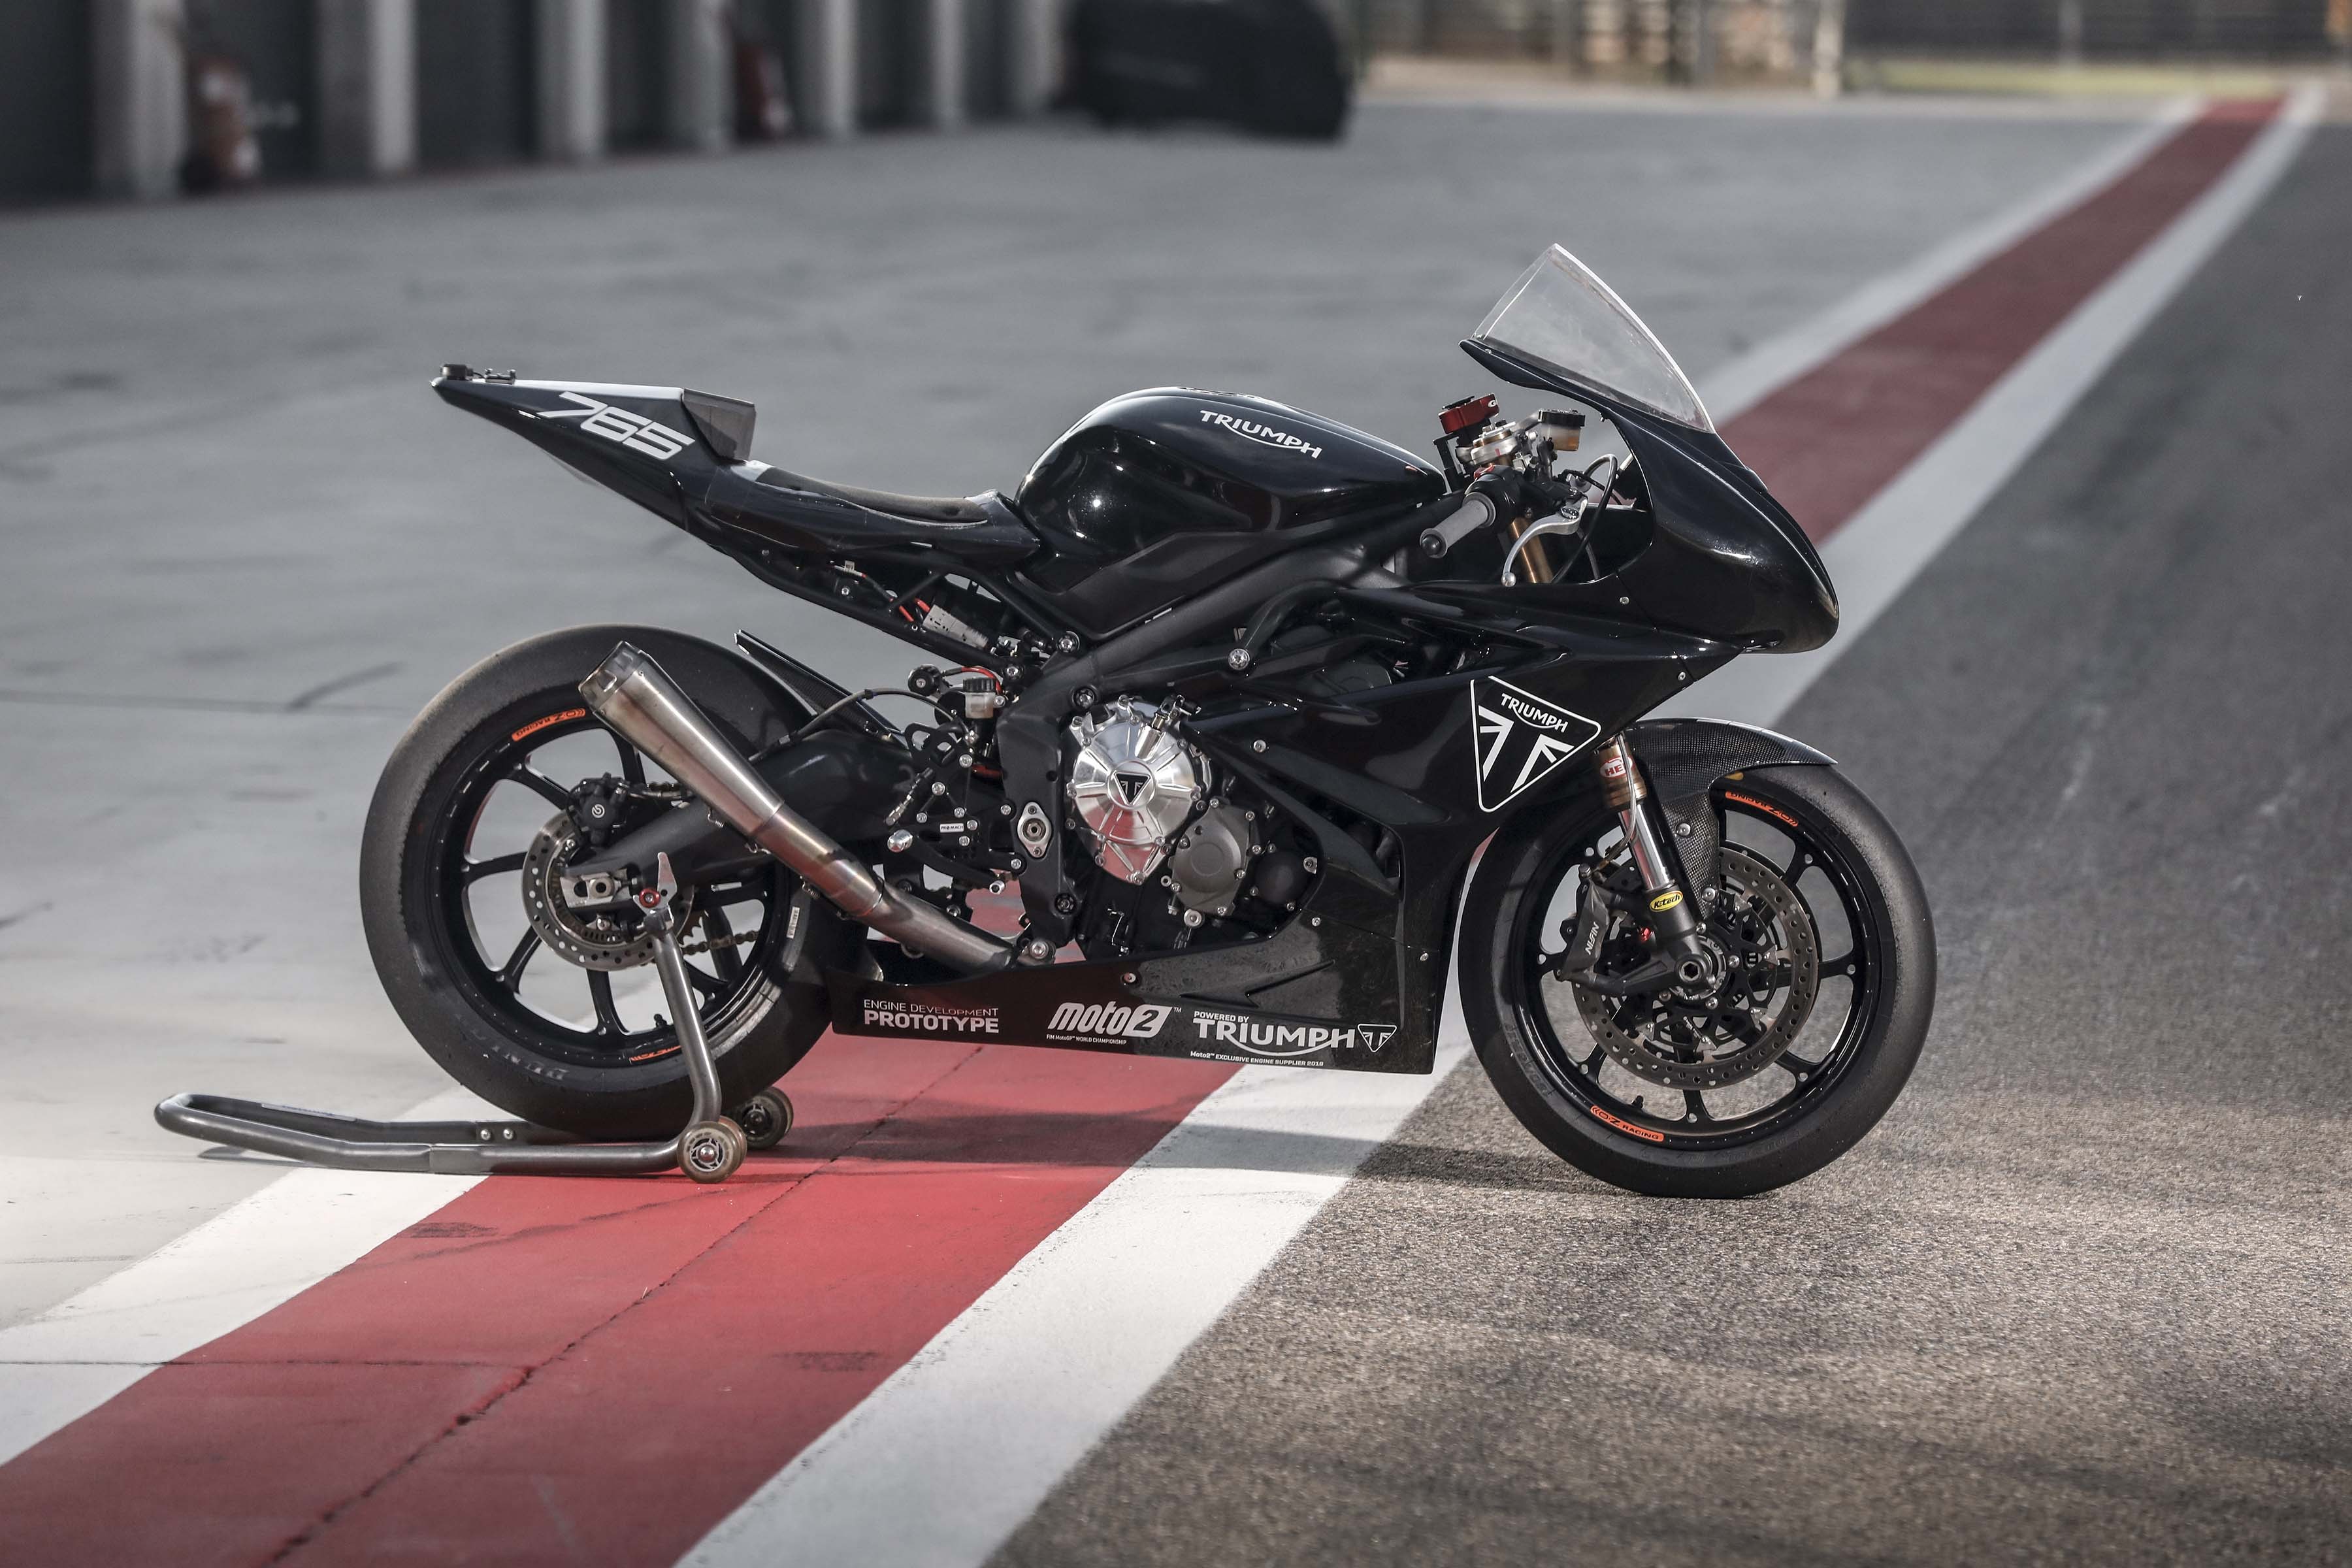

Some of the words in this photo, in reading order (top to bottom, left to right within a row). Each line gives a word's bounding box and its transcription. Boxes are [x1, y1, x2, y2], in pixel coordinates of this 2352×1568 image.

[536, 391, 696, 461] 765
[1200, 410, 1323, 459] TRIUMPH
[1500, 693, 1569, 733] TRIUMPH
[864, 999, 907, 1011] ENGINE
[910, 1004, 999, 1017] DEVELOPMENT
[1194, 1011, 1236, 1022] POWERED
[864, 1009, 999, 1034] PROTOTYPE
[1192, 1018, 1355, 1056] TRIUMPH
[1215, 1054, 1249, 1063] EXCLUSIVE
[1622, 1124, 1659, 1140] RACING
